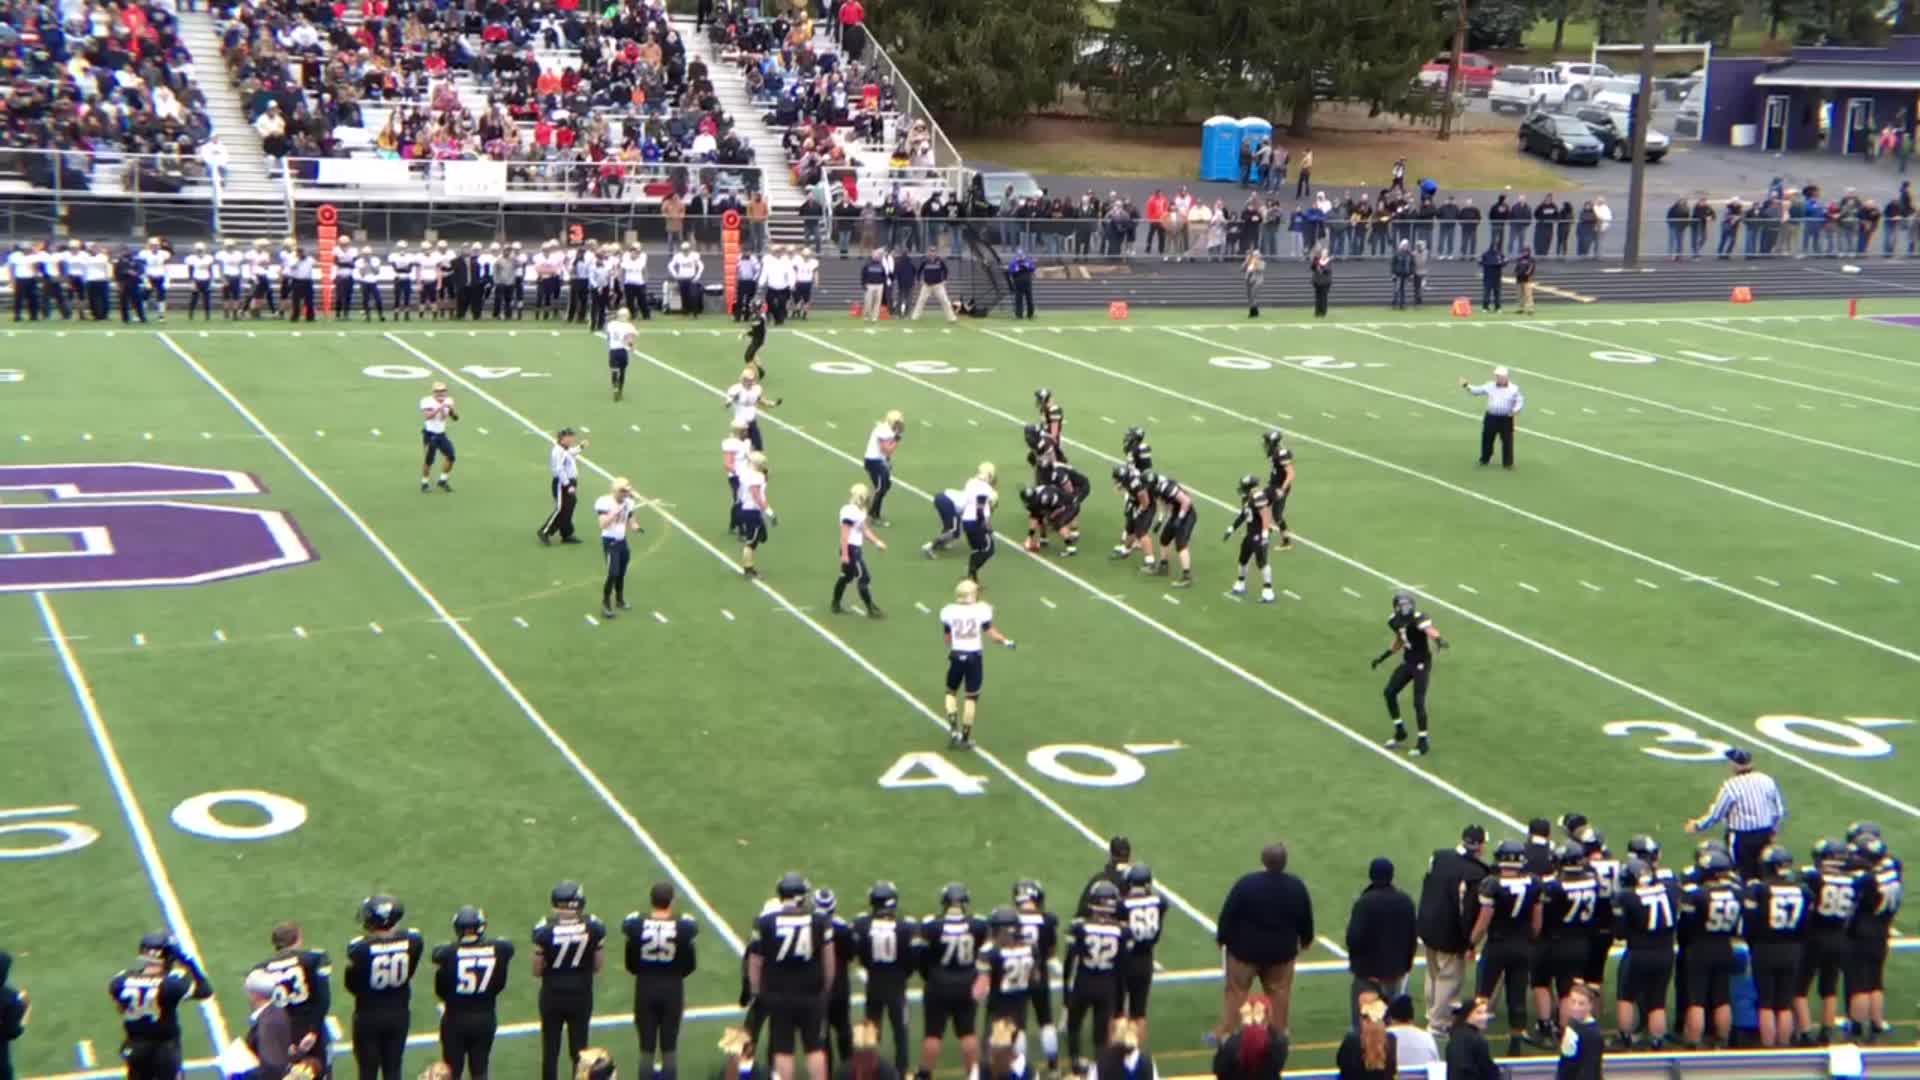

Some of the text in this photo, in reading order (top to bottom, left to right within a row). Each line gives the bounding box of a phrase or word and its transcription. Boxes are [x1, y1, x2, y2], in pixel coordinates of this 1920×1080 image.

[569, 224, 583, 243] 3
[1603, 715, 1892, 760] 30
[878, 744, 1146, 794] 40
[1508, 883, 1527, 918] 7
[1562, 890, 1597, 924] 73
[1640, 893, 1674, 931] 71
[1768, 894, 1803, 929] 67
[552, 932, 590, 969] 77
[640, 928, 677, 963] 25
[775, 925, 813, 962] 74
[1083, 935, 1119, 971] 32
[370, 951, 410, 990] 60
[456, 956, 496, 995] 57
